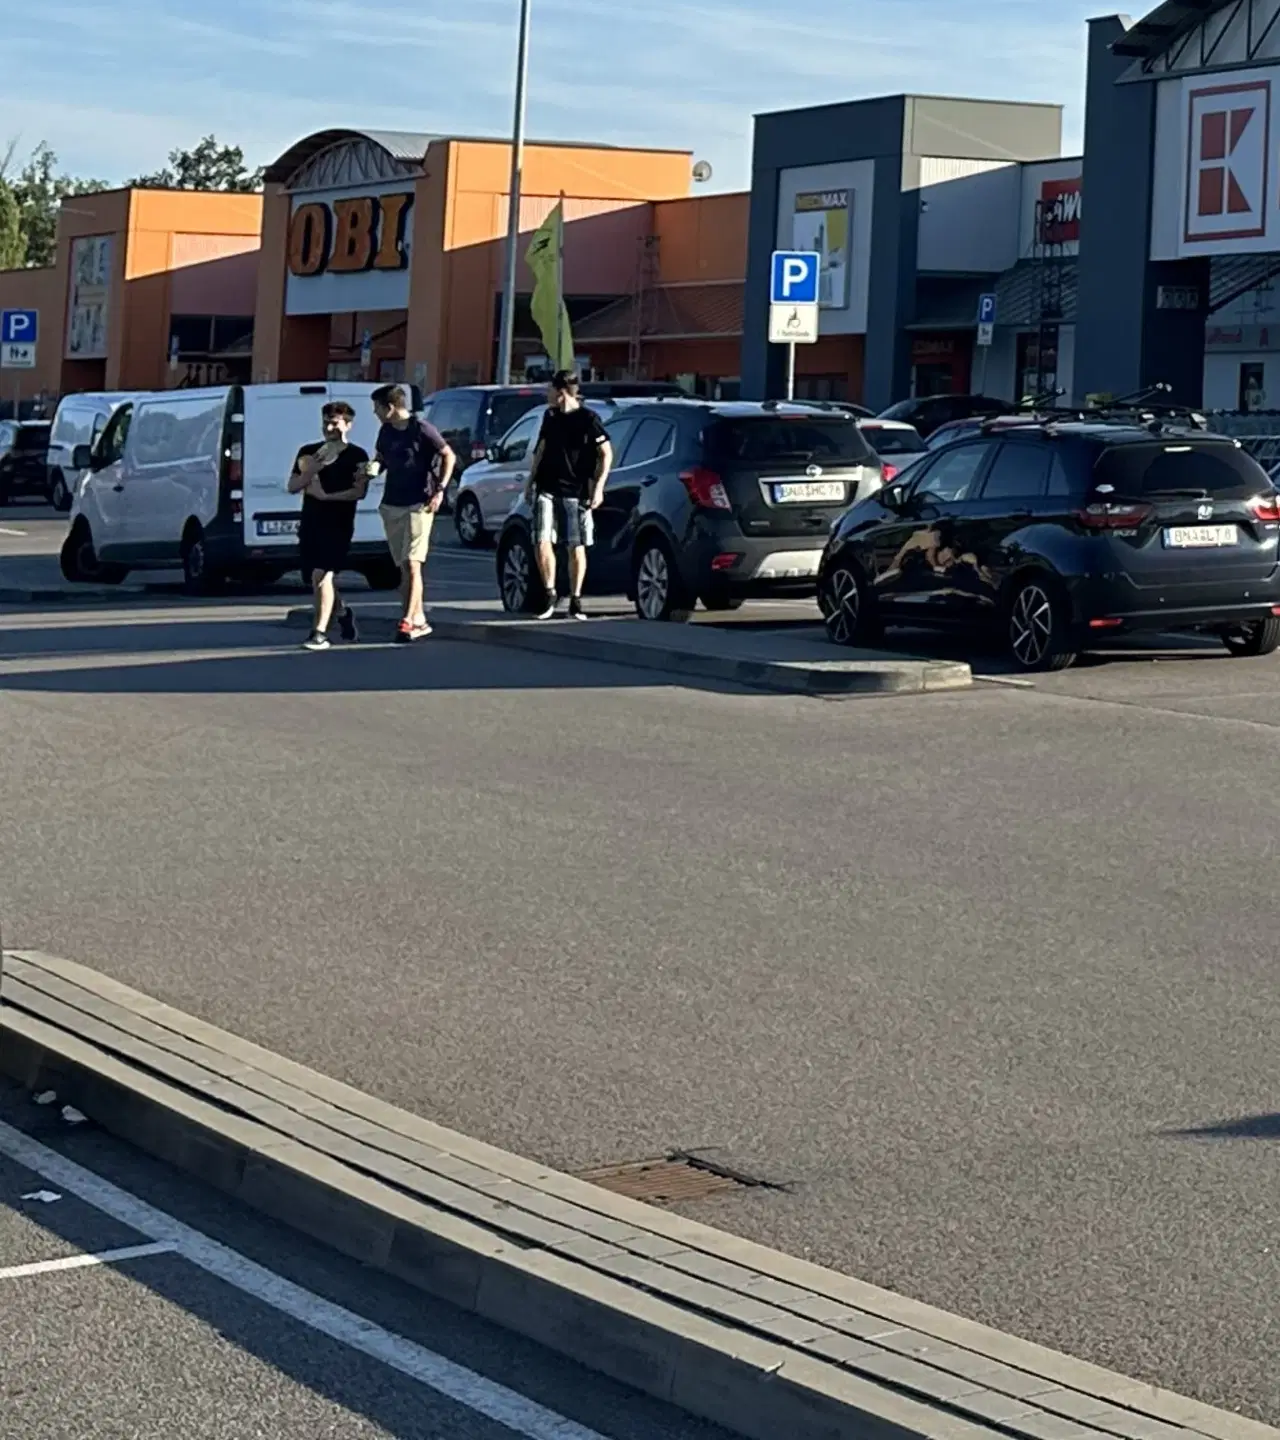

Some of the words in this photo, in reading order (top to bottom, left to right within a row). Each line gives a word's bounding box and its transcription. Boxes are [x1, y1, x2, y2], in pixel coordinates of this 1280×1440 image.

[289, 193, 413, 275] OBI
[782, 259, 807, 297] P
[981, 297, 993, 321] P
[10, 313, 30, 340] P
